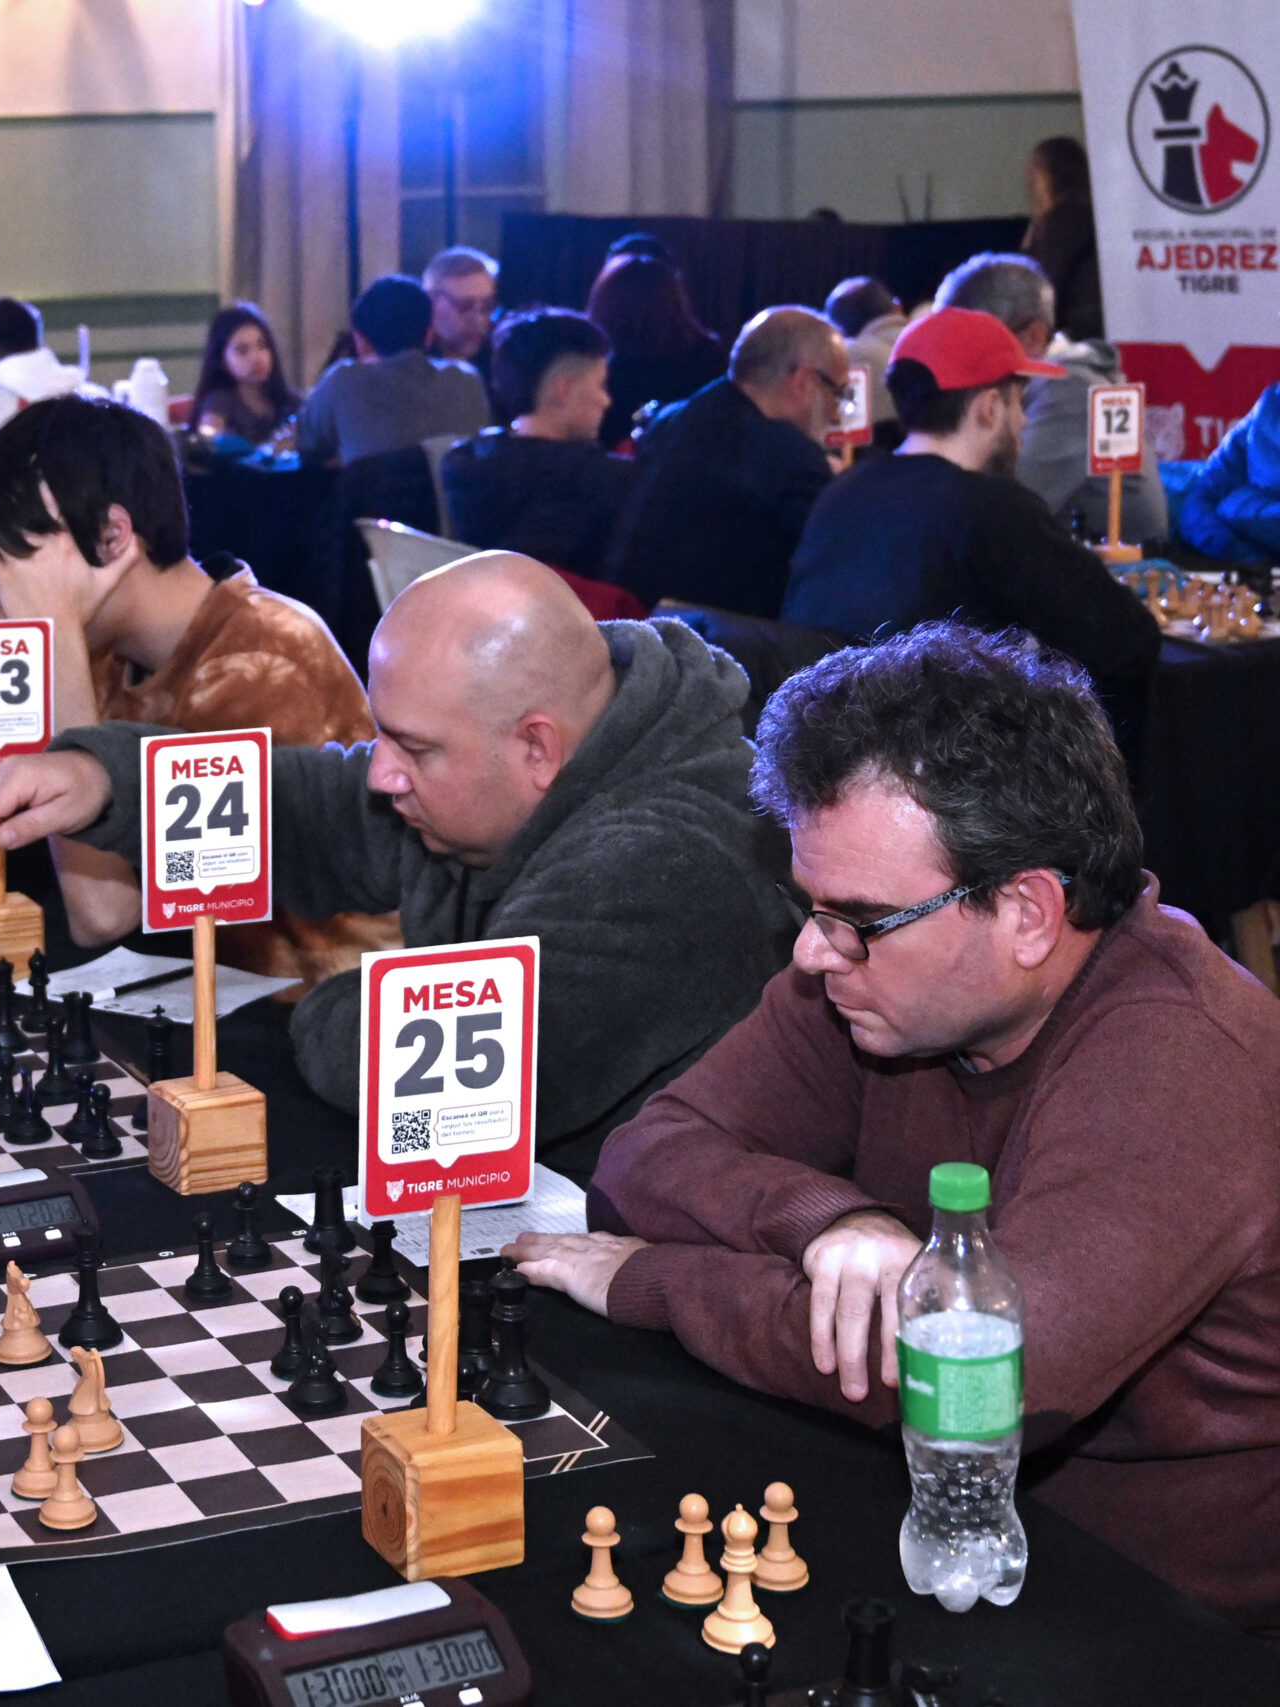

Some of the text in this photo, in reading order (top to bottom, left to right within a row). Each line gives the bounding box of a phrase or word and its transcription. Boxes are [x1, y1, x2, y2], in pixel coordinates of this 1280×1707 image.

[1137, 244, 1278, 271] AJEDREZ
[1177, 275, 1240, 295] TIGRE
[1102, 409, 1130, 434] 12
[171, 755, 244, 780] MESA
[165, 781, 249, 842] 24
[177, 898, 255, 913] TIGRE MUNICIPIO
[403, 977, 503, 1014] MESA
[394, 1011, 505, 1098] 25
[407, 1171, 511, 1194] TIGRE MUNICIPIO
